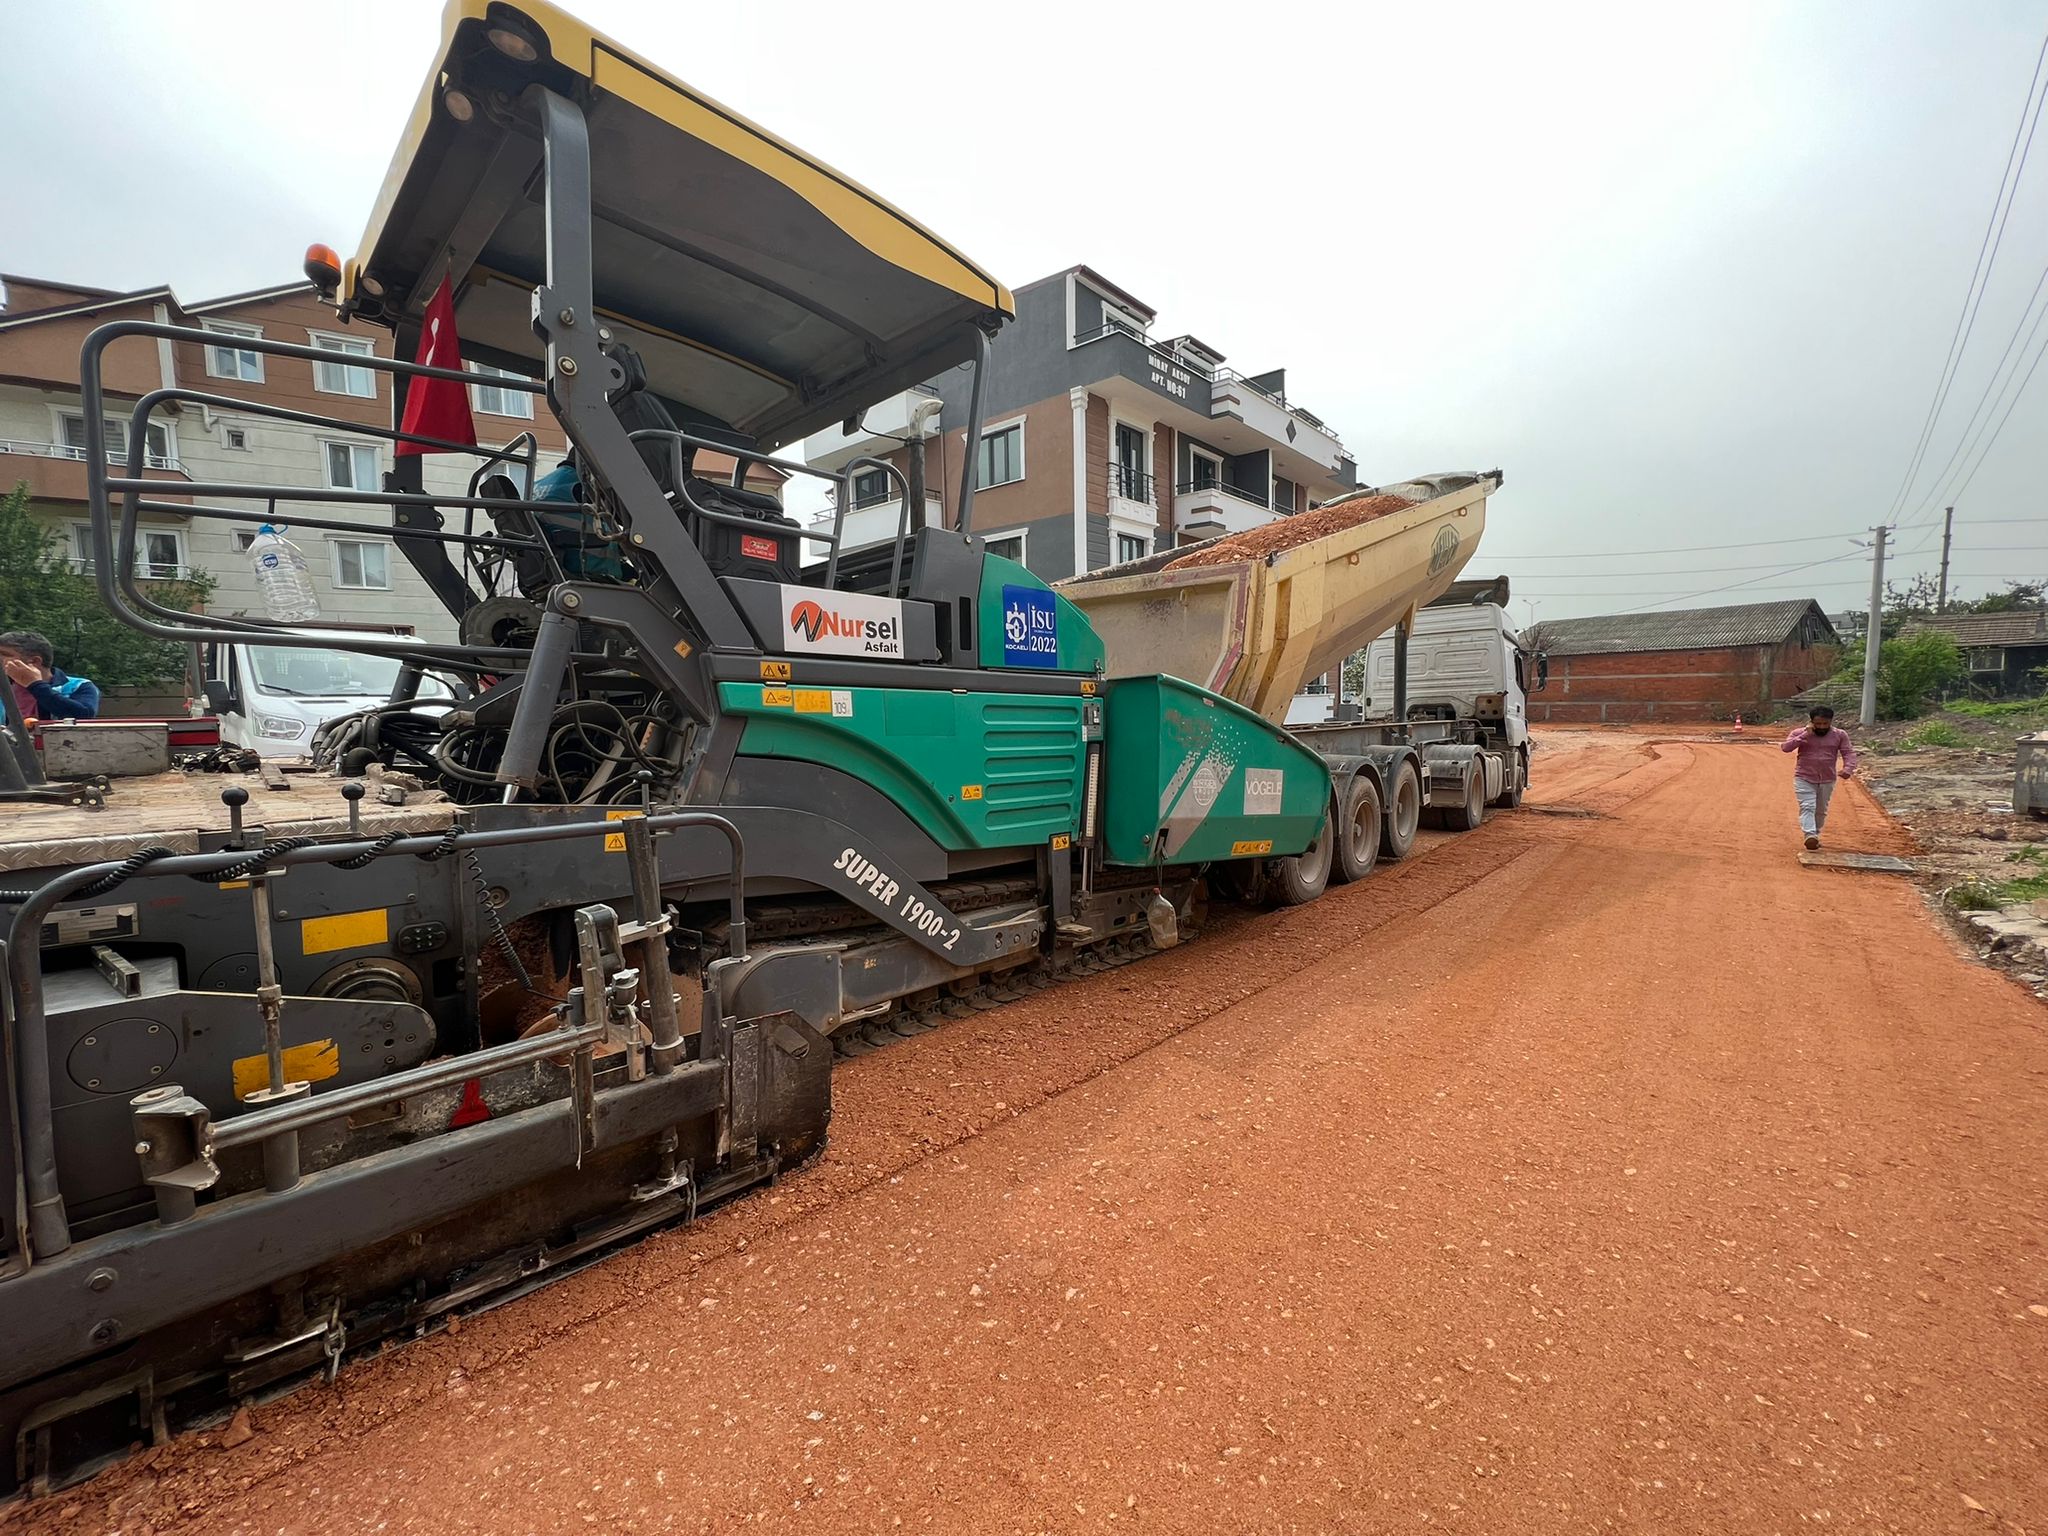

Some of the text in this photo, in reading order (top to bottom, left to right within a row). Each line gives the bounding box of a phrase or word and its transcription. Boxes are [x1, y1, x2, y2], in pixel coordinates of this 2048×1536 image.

[821, 610, 897, 640] Nursel
[865, 641, 898, 653] Asfalt
[1031, 635, 1056, 653] 2022
[833, 848, 960, 950] SUPER 1900-2
